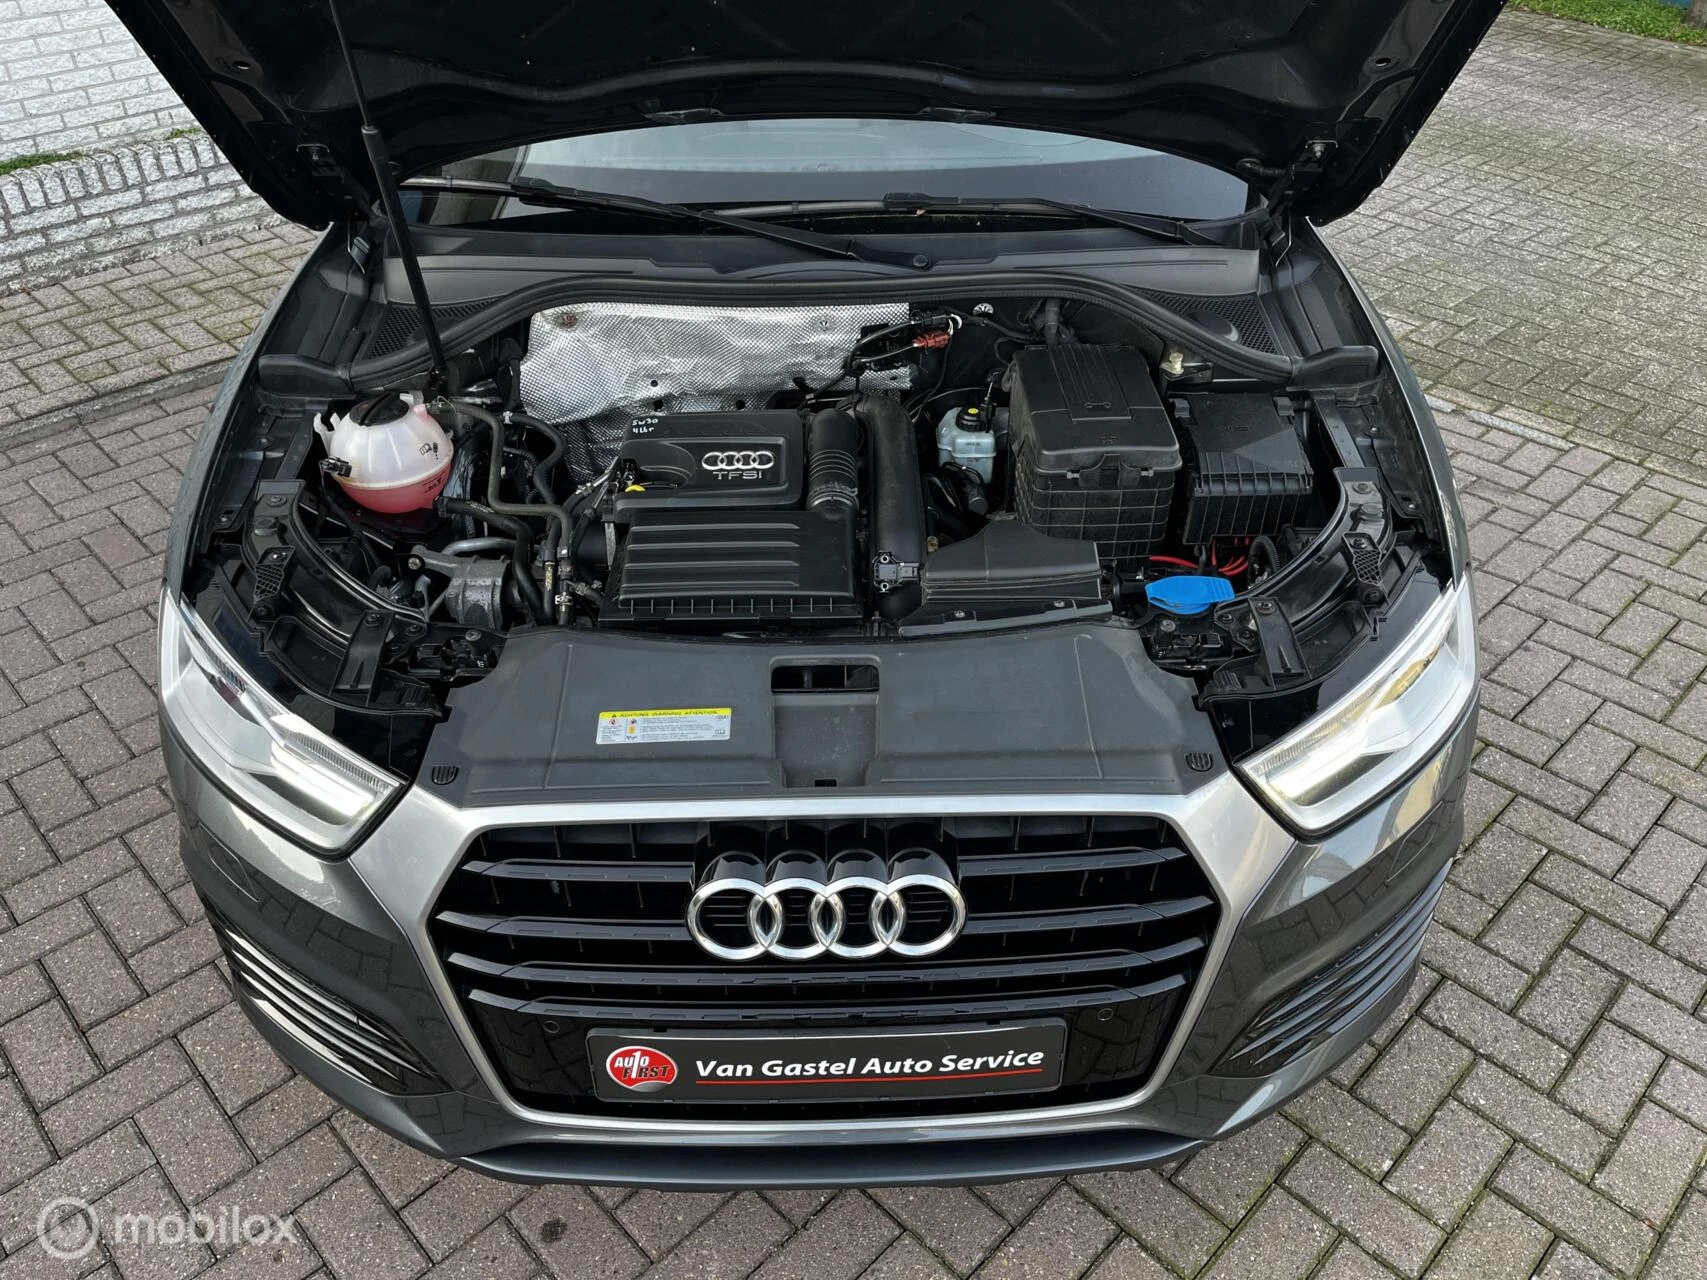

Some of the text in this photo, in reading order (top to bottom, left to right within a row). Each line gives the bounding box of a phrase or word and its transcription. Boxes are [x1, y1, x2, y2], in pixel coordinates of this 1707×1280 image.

[712, 470, 763, 480] TFSI
[695, 1050, 1044, 1077] Van Gastel Auto Service
